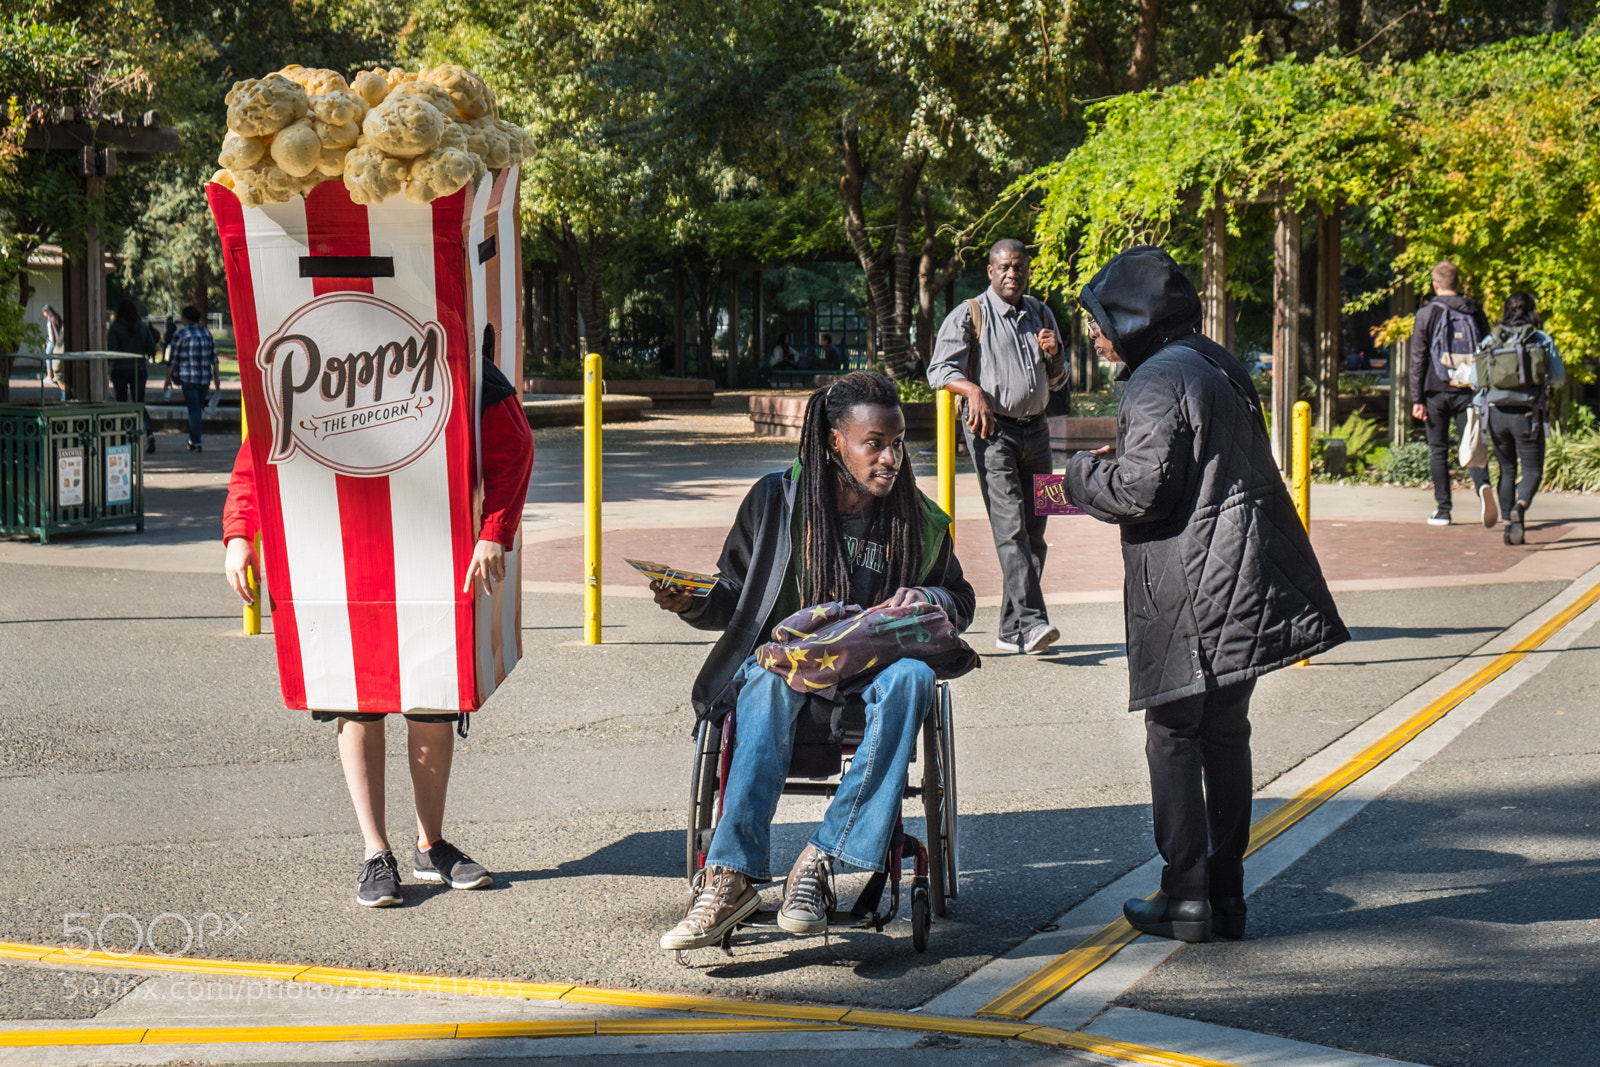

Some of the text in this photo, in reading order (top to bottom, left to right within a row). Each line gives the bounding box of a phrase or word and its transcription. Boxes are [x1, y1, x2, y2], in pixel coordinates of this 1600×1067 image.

[264, 329, 438, 454] Poppy
[322, 402, 410, 433] THE POPCORN
[58, 449, 83, 458] LANDFILL
